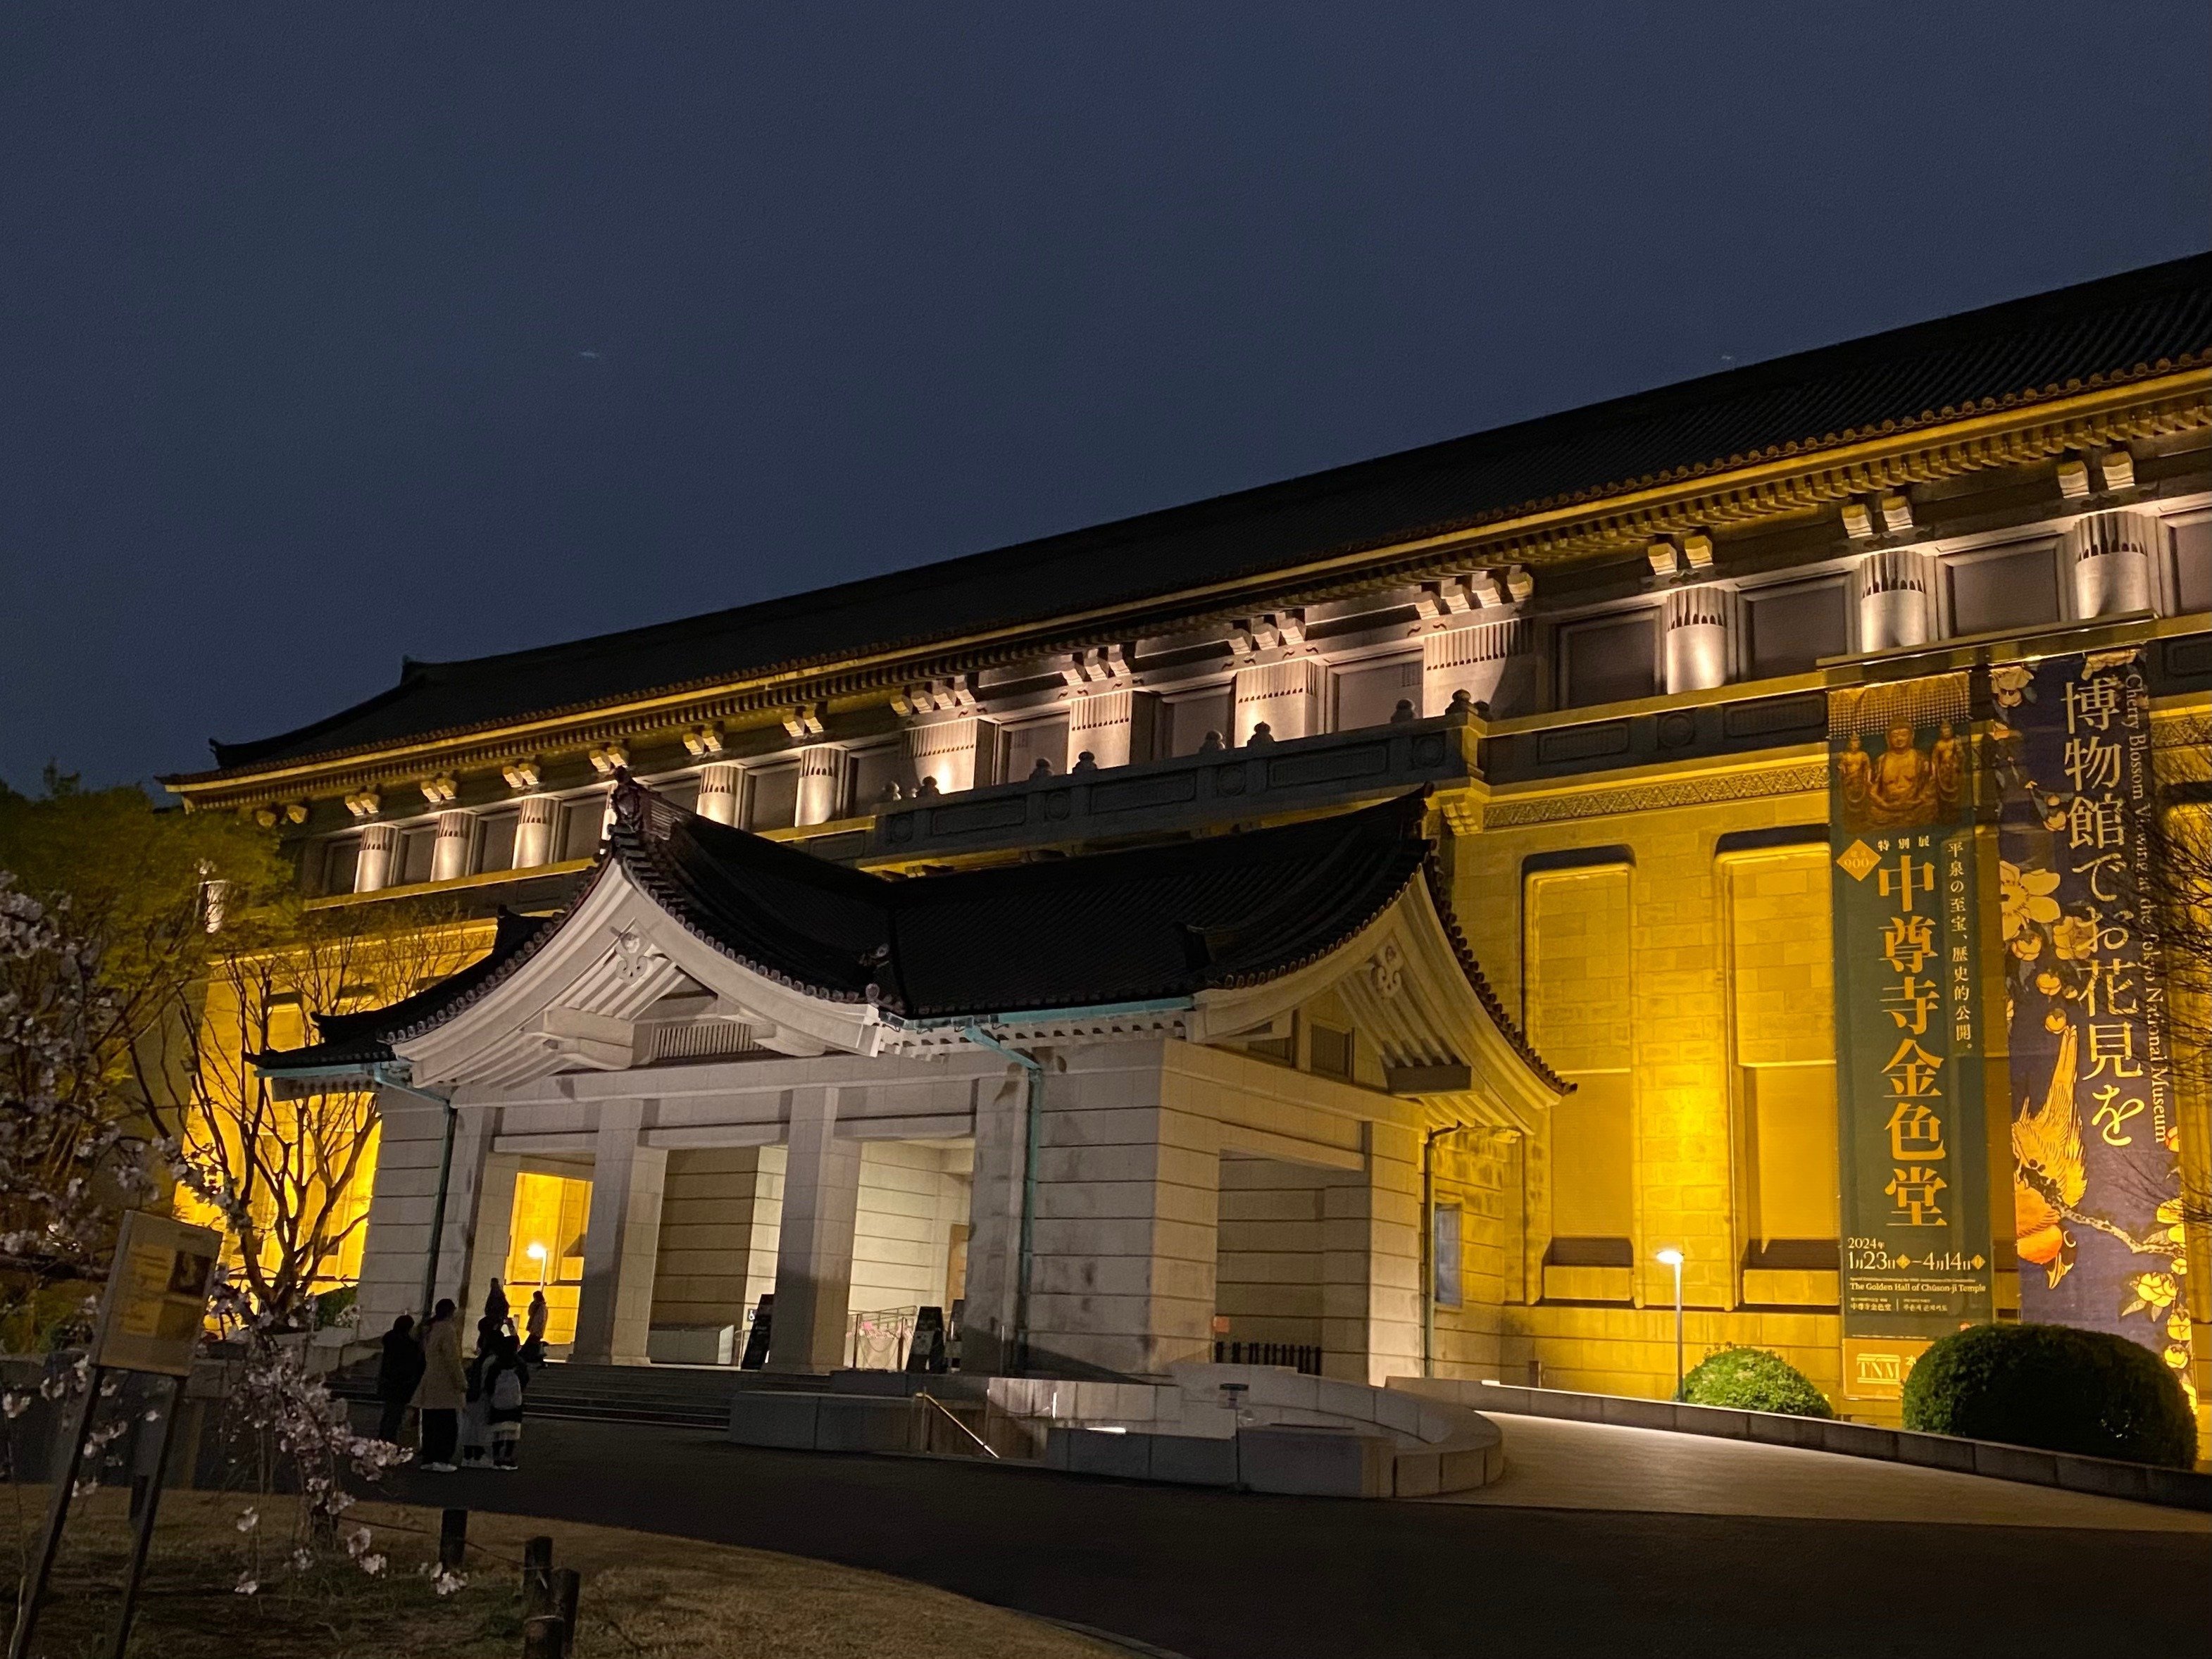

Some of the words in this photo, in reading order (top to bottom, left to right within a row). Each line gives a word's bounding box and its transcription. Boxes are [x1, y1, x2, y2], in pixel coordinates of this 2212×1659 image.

[2121, 674, 2144, 730] Cherry
[2129, 734, 2148, 799] Blossom
[1877, 836, 1929, 851] 特別展
[2061, 677, 2145, 1146] 博物館でお花見を
[1948, 841, 1972, 1048] 平泉の至宝、歴史的公開。
[1878, 854, 1947, 1226] 中尊寺金色堂
[2146, 987, 2168, 1062] National
[2151, 1066, 2170, 1144] Museum
[1847, 1237, 1885, 1249] 2024年
[1850, 1282, 1864, 1291] The
[1911, 1283, 1920, 1291] of
[1958, 1284, 1986, 1294] Temple
[1856, 1358, 1901, 1380] TNM
